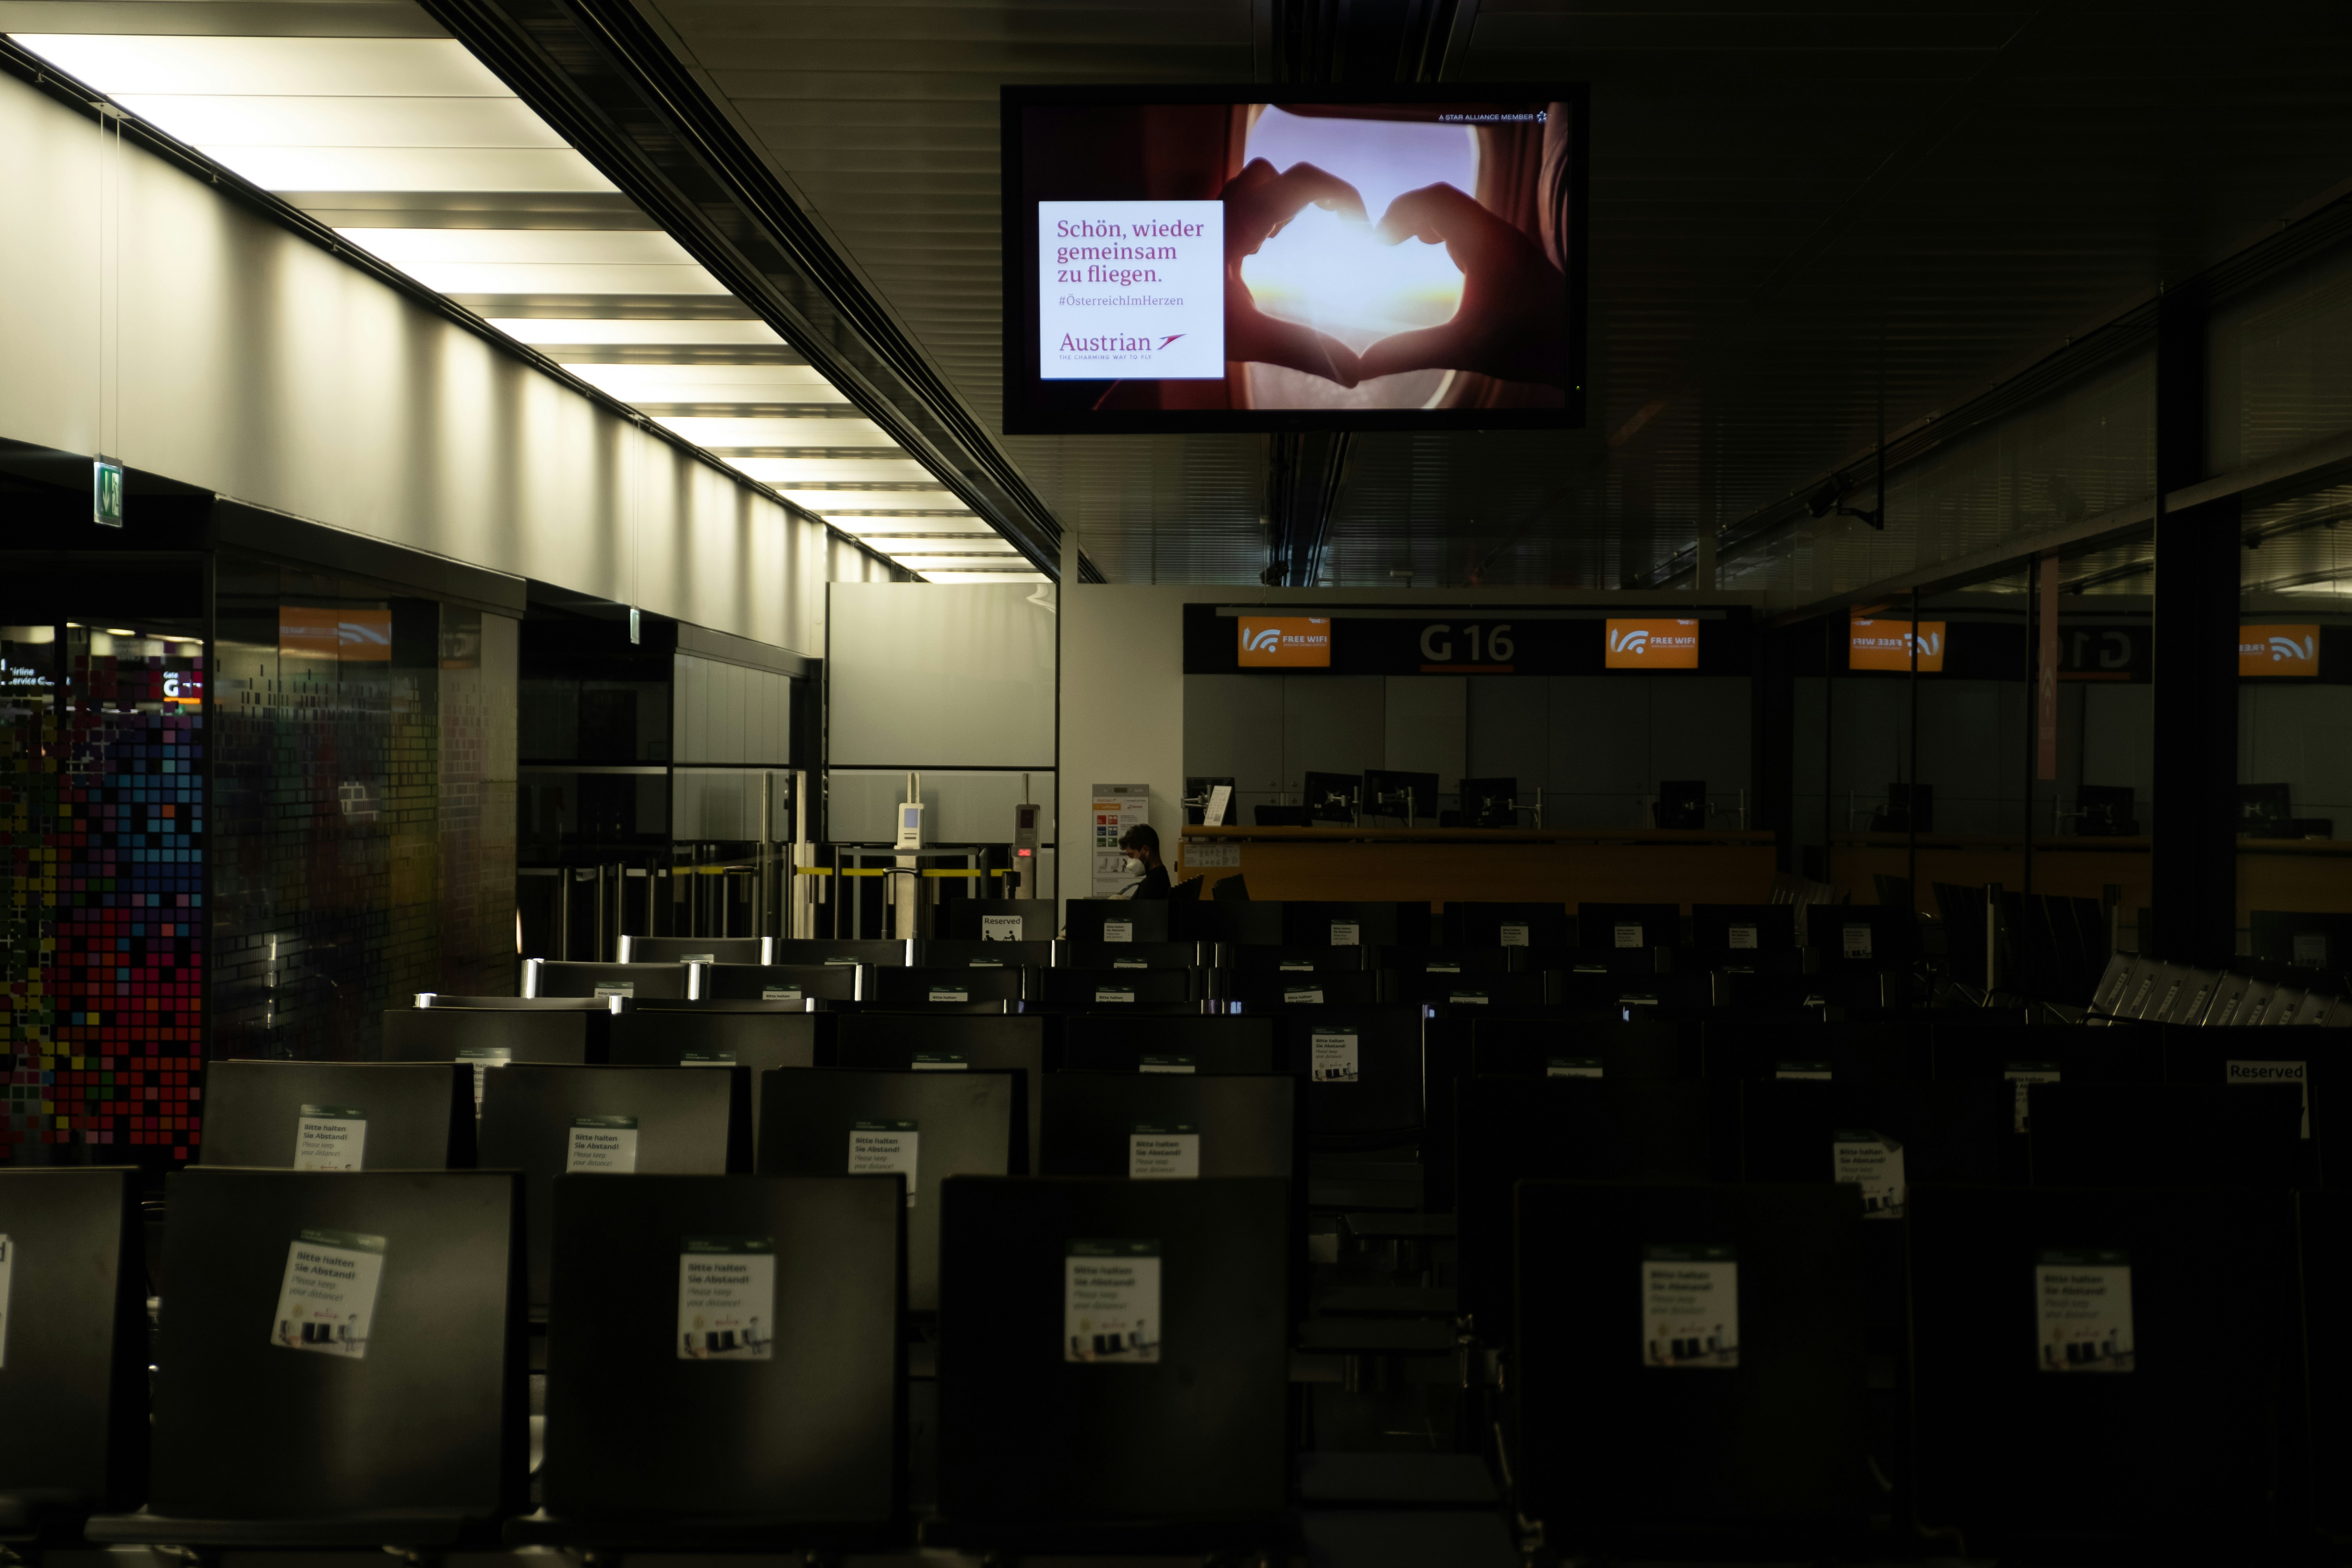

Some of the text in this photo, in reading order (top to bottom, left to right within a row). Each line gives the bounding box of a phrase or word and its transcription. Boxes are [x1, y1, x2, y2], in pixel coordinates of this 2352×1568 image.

[1057, 219, 1204, 239] Schön, wieder
[1057, 242, 1177, 263] gemeinsam
[1058, 265, 1162, 286] zu fliegen.
[1059, 294, 1183, 306] #ÖsterreichImHerzen
[1059, 332, 1151, 351] Austrian
[10, 667, 34, 676] irline
[8, 676, 37, 685] ervice
[2231, 1065, 2303, 1077] Reserved
[297, 1252, 354, 1268] Bitte halten
[688, 1263, 746, 1272] Bitte halten
[294, 1263, 355, 1279] Sie Abstand!
